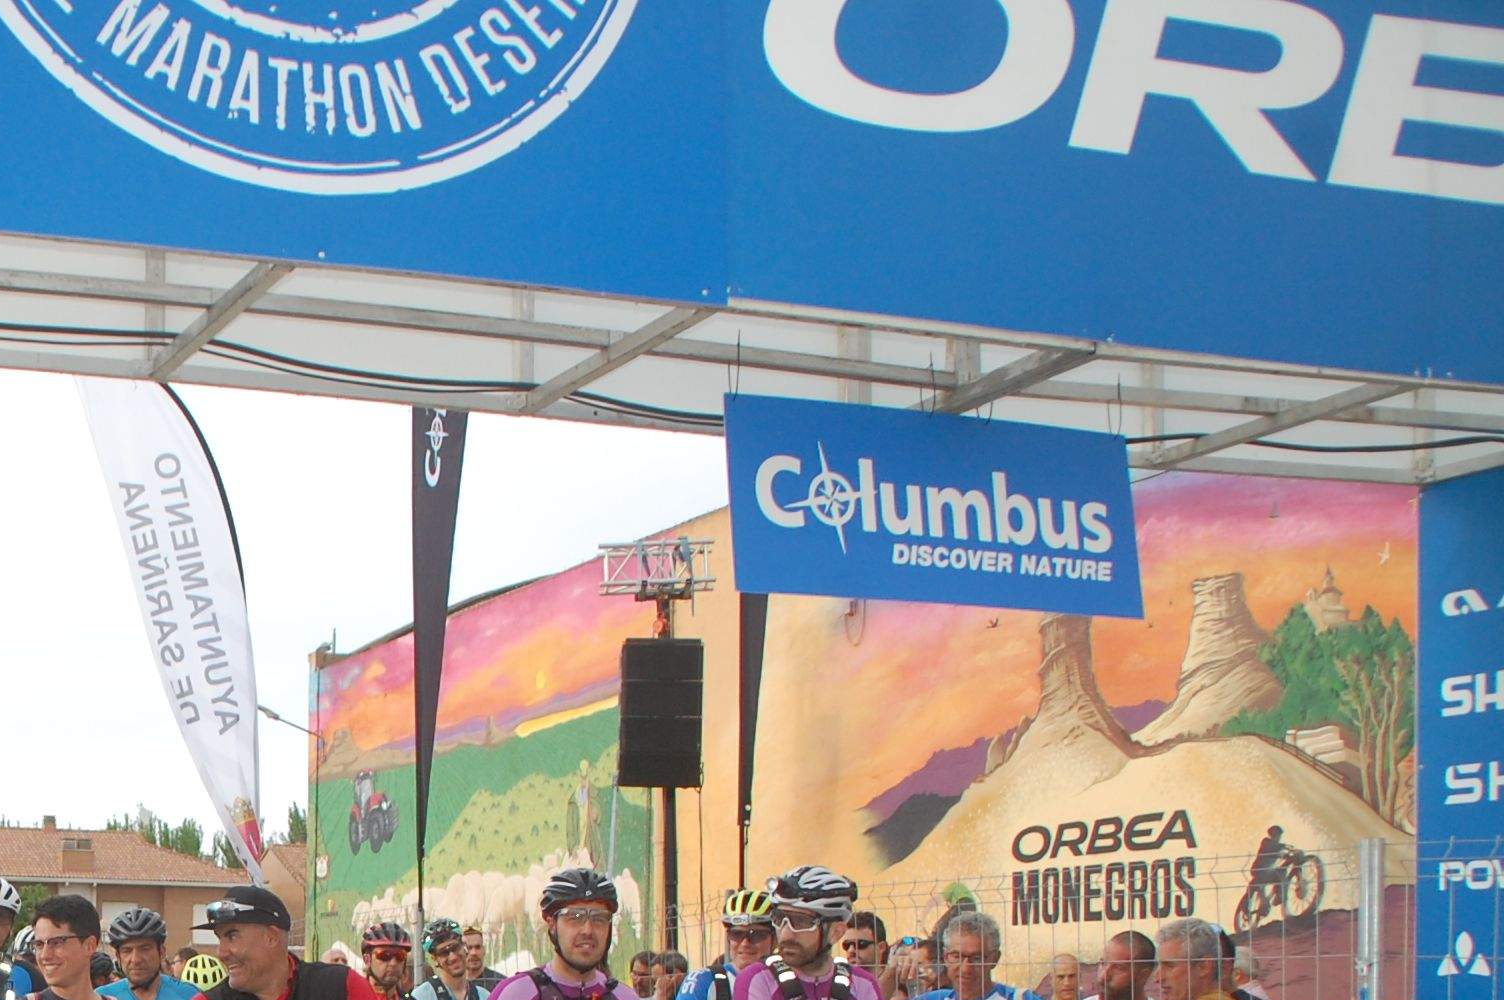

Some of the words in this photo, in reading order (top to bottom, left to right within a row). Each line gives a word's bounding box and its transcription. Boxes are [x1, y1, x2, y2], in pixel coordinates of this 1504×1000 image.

[97, 0, 422, 138] MARATHON
[419, 0, 585, 114] DESE
[763, 0, 1504, 204] ORB
[754, 443, 1114, 555] Columbus
[892, 543, 1013, 574] DISCOVER
[1020, 553, 1114, 583] NATURE
[1011, 808, 1197, 863] ORBEA
[1011, 856, 1196, 927] MONEGROS
